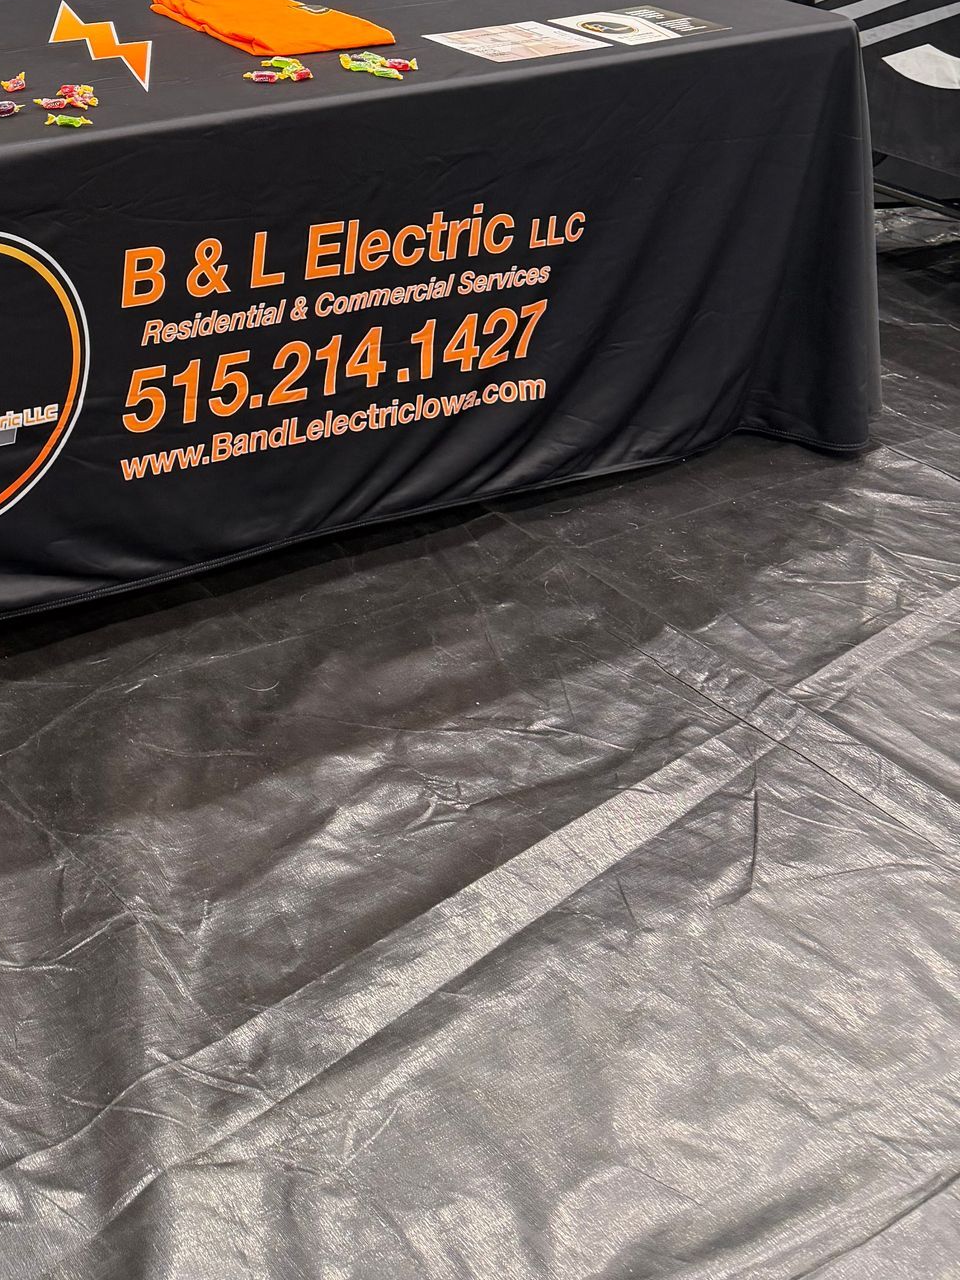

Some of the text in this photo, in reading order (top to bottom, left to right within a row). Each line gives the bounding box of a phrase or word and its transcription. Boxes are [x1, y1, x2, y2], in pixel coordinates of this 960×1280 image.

[121, 203, 586, 308] B & L Electric LLC
[141, 265, 551, 346] Residential & Commercial Services
[23, 403, 59, 427] LLC
[121, 299, 549, 434] 515.214.1427
[120, 377, 547, 481] www.BandLelectricIowa.com
